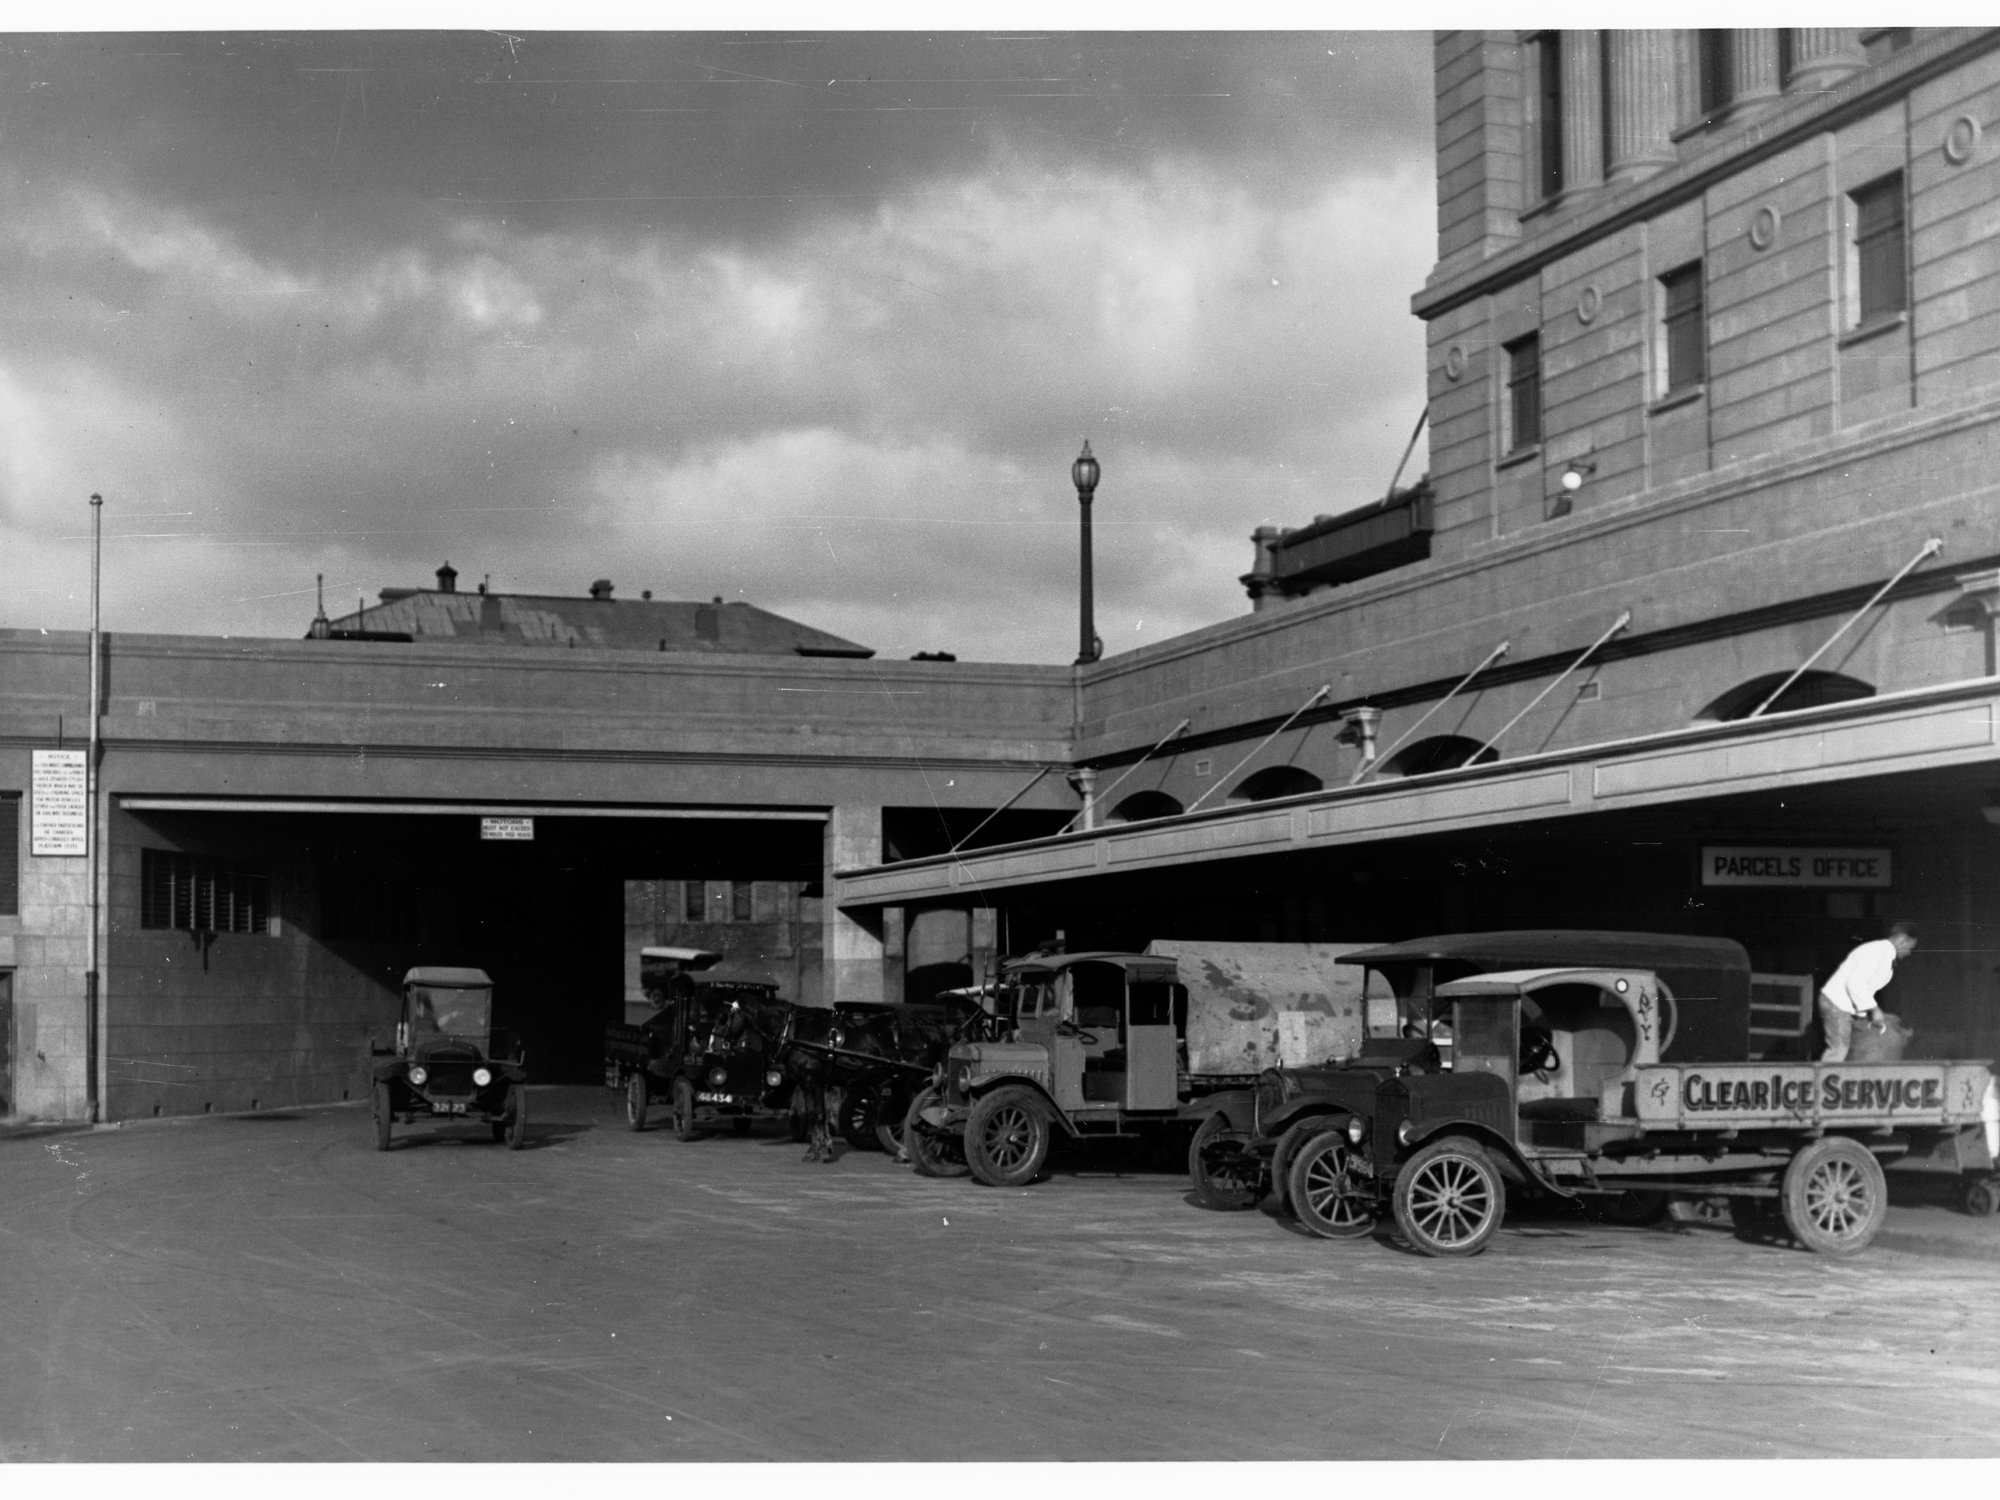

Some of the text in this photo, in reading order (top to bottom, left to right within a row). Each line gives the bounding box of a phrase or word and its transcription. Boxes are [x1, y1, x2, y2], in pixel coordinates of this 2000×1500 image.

[1714, 856, 1879, 878] PARCELS OFFICE
[1821, 1074, 1944, 1110] SERVICE
